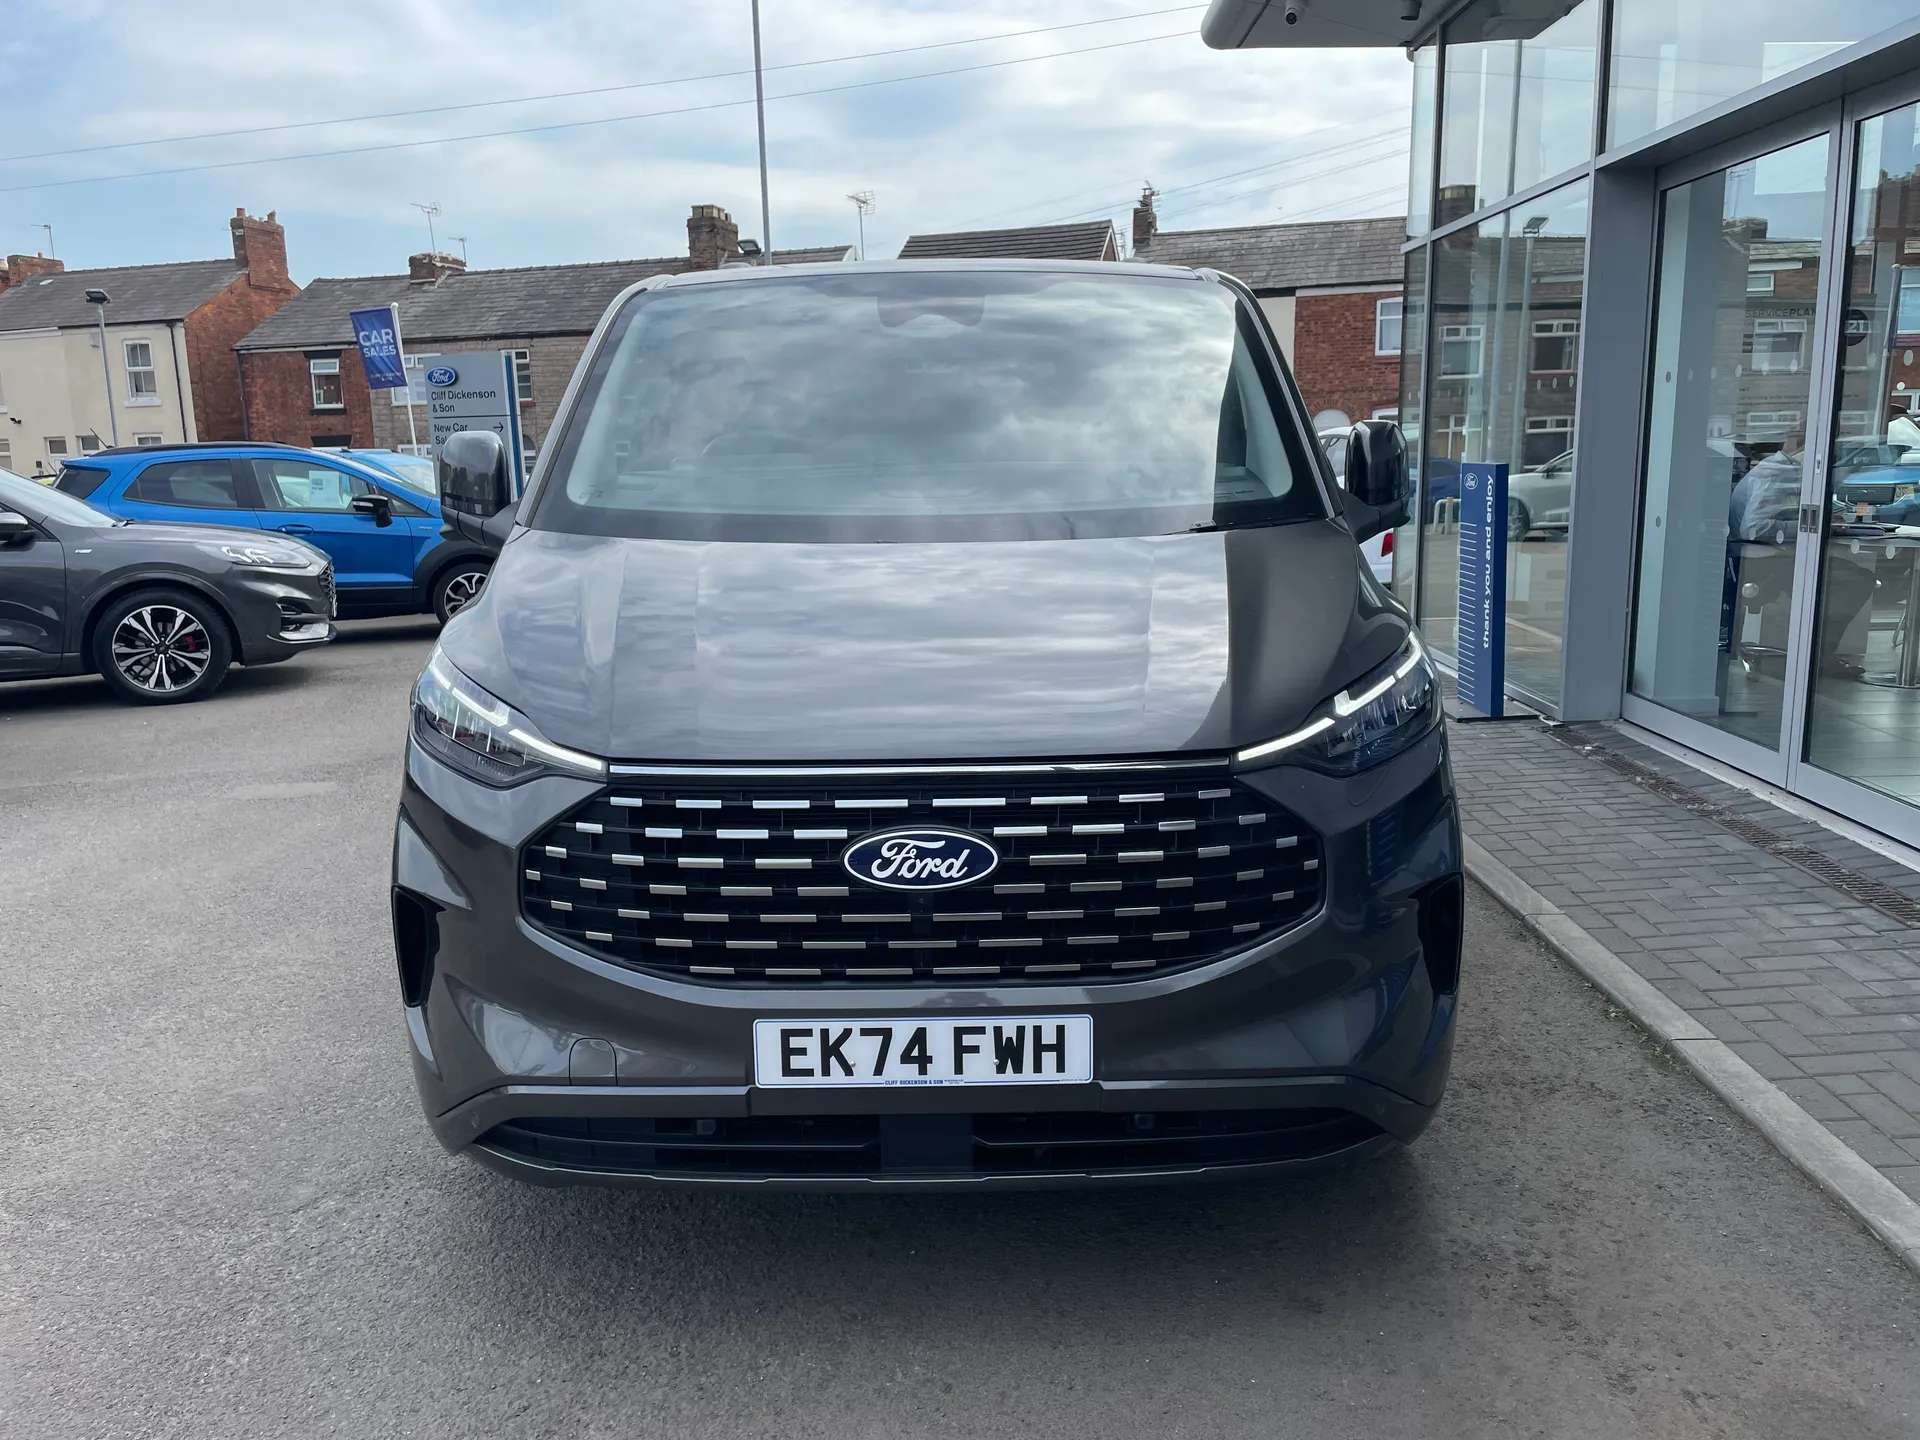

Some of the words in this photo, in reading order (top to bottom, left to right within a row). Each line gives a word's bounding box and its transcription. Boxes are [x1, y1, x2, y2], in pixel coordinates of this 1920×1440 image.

[359, 328, 394, 346] CAR
[363, 344, 396, 358] SALES
[447, 389, 496, 400] Dickenson
[439, 402, 455, 413] Son
[434, 423, 451, 433] New
[452, 422, 468, 432] Car
[1486, 474, 1494, 524] enjoy
[1484, 564, 1492, 596] you
[871, 838, 971, 879] Ford
[780, 1026, 933, 1077] EK74
[953, 1024, 1066, 1075] FWH
